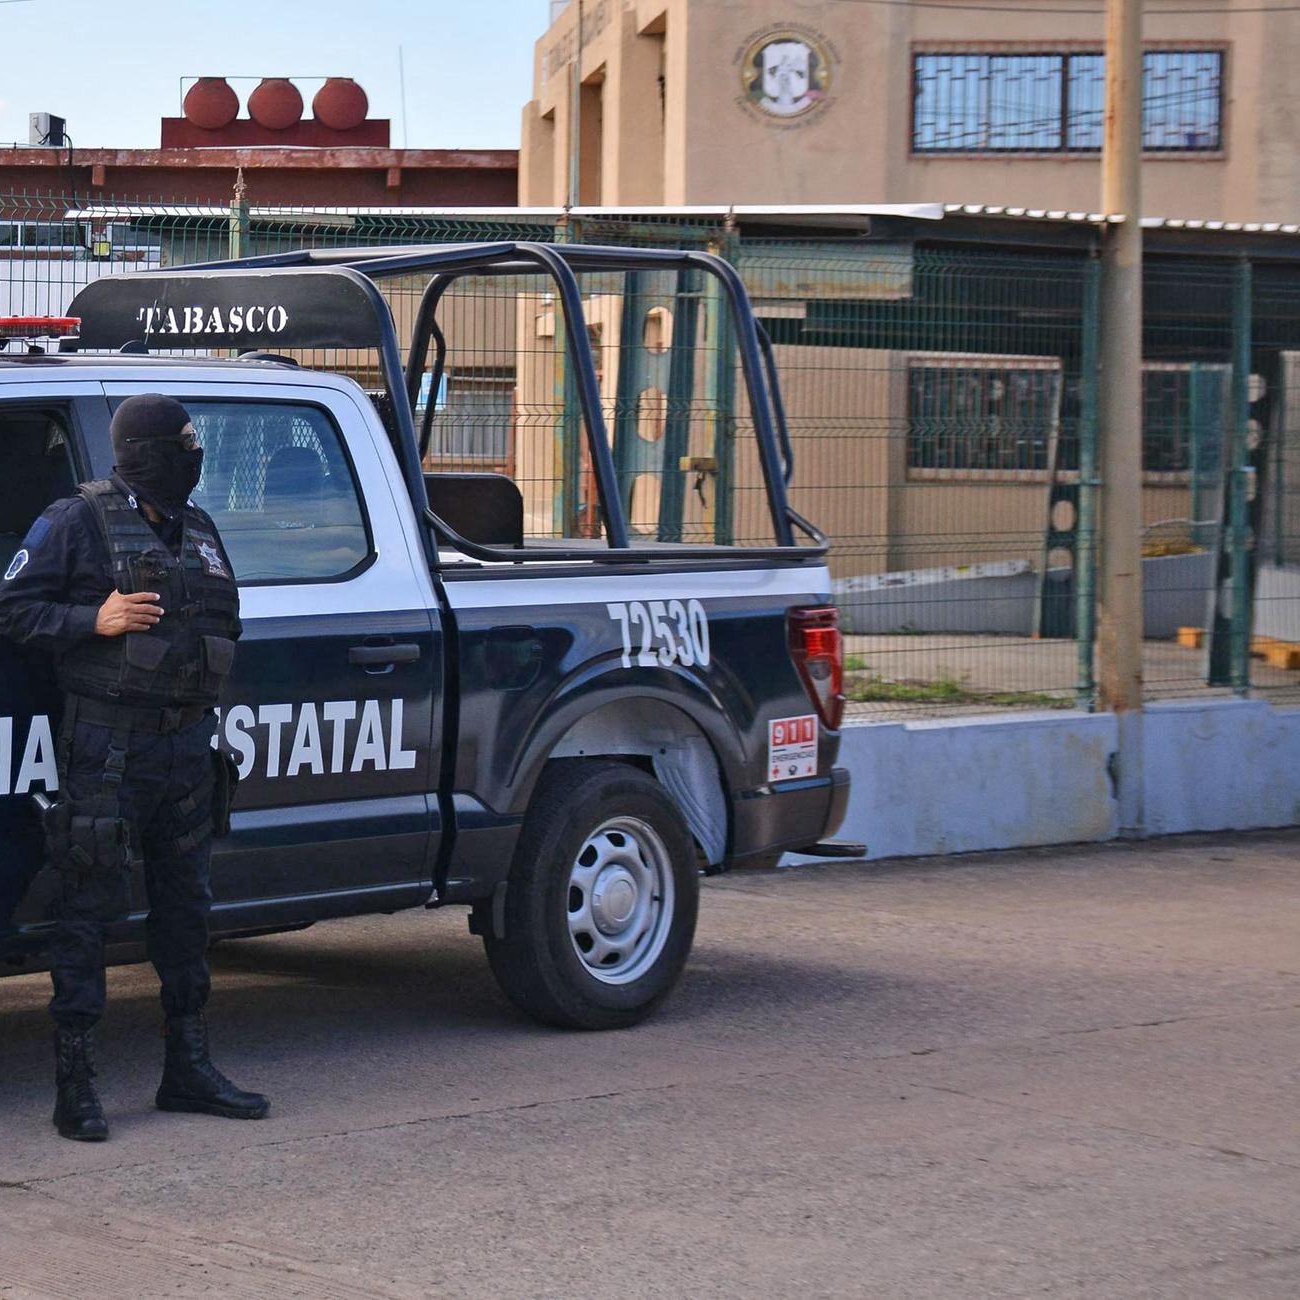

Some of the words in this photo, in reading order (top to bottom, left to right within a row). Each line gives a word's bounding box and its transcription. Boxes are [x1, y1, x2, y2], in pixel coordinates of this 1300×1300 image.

[136, 305, 289, 334] TABASCO
[606, 599, 710, 668] 72530
[774, 721, 812, 744] 911
